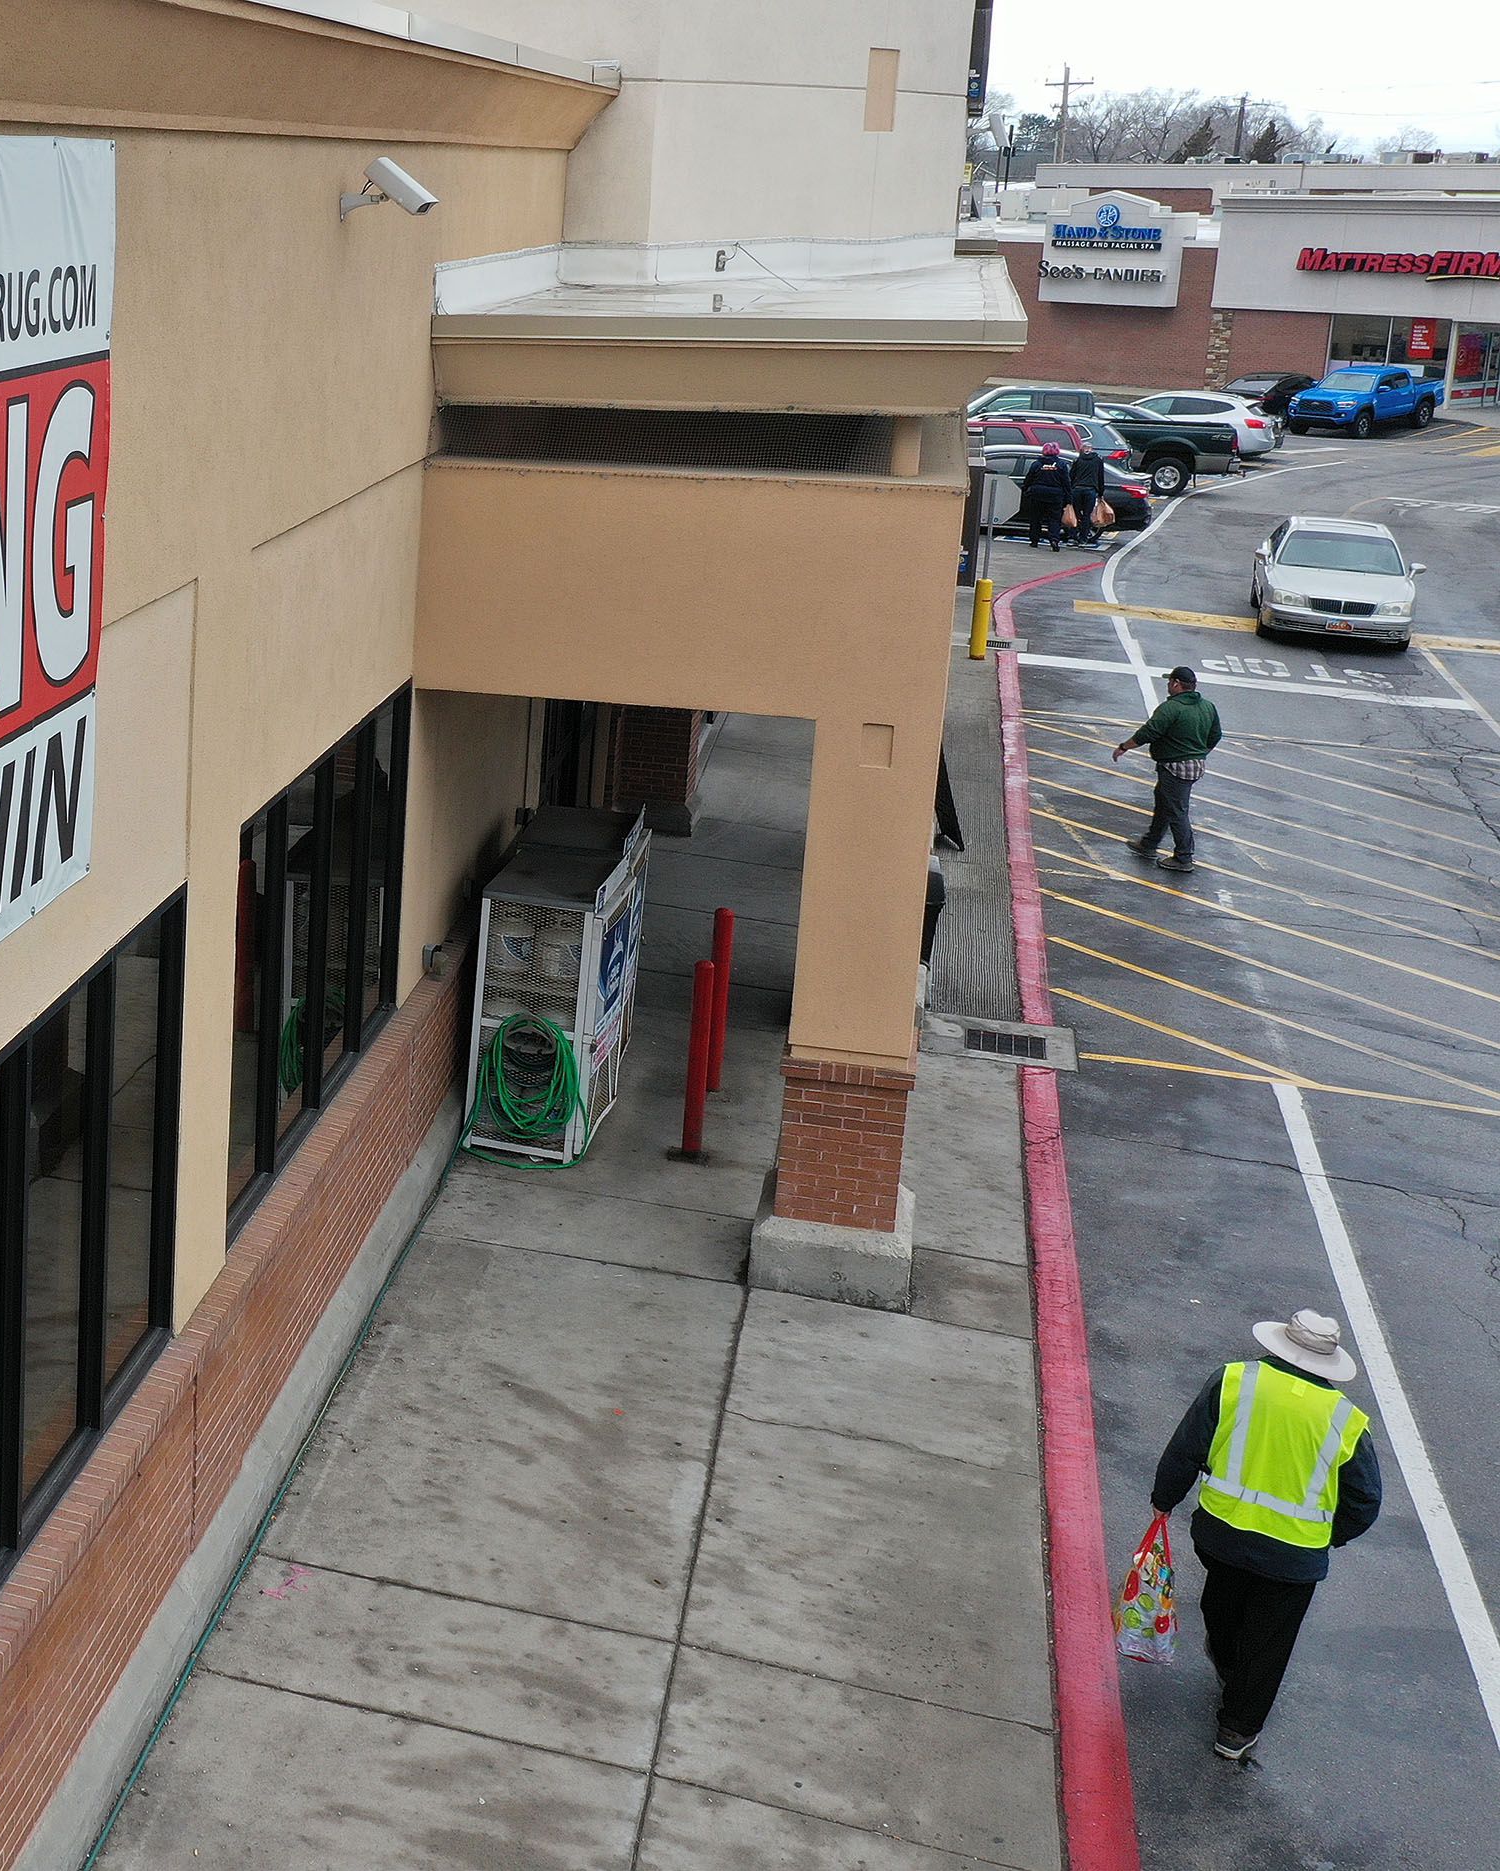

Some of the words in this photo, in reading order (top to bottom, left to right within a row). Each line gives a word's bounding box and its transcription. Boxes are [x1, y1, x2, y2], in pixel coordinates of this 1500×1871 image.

[1055, 240, 1090, 248] MASSAGE
[1092, 241, 1109, 249] AND
[1111, 242, 1138, 250] FACIAL
[1038, 260, 1085, 280] See's
[1093, 267, 1163, 283] CANDIES
[1200, 655, 1395, 689] STOP
